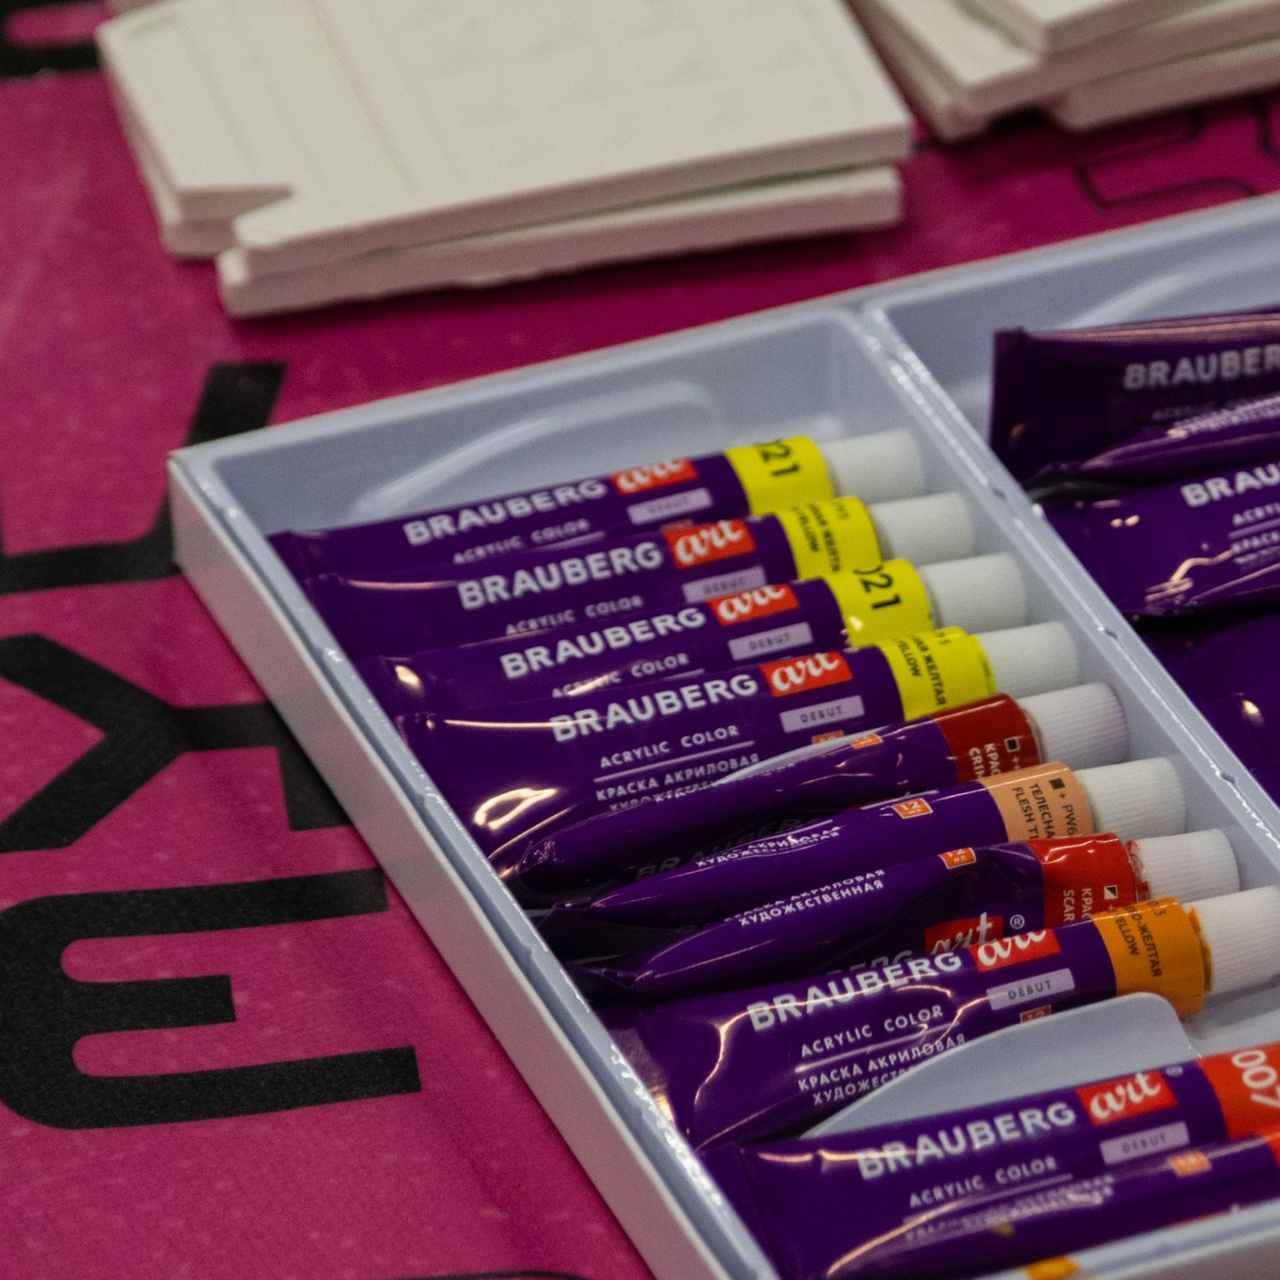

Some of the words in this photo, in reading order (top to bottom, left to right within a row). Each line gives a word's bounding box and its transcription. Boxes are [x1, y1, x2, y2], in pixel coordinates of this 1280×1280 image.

[756, 440, 801, 478] 21
[403, 480, 607, 547] BRAUBERG
[453, 536, 524, 565] ACRYLIC
[531, 519, 591, 544] COLOR
[457, 541, 663, 610] BRAUBERG
[674, 519, 743, 565] art
[505, 609, 576, 637] ACRYLIC
[584, 595, 643, 619] COLOR
[501, 608, 706, 679] BRAUBERG
[749, 632, 791, 652] DEBUT
[630, 653, 690, 678] COLOR
[923, 652, 947, 707] ЖЕЛТАЯ
[549, 674, 759, 742] BRAUBERG
[771, 651, 840, 692] art
[800, 705, 844, 724] DEBUT
[600, 741, 670, 770] ACRYLIC
[681, 725, 739, 748] COLOR
[596, 775, 659, 802] КРАСКА
[664, 753, 760, 785] АКРИЛОВАЯ
[1012, 786, 1035, 825] FLESH
[1061, 803, 1079, 836] PW6
[739, 879, 884, 927] ХУДОЖЕСТВЕННАЯ
[1114, 913, 1140, 956] ELLOW
[747, 952, 962, 1031] BRAUBERG
[1007, 980, 1053, 1001] DEBUT
[801, 1024, 872, 1058] ACRYLIC
[884, 1005, 943, 1032] COLOR
[798, 1063, 863, 1092] КРАСКА
[857, 1101, 1076, 1181] BRAUBERG
[1090, 1072, 1161, 1120] art
[1121, 1132, 1167, 1154] DEBUT
[909, 1175, 985, 1208] ACRYLIC
[995, 1156, 1057, 1184] COLOR
